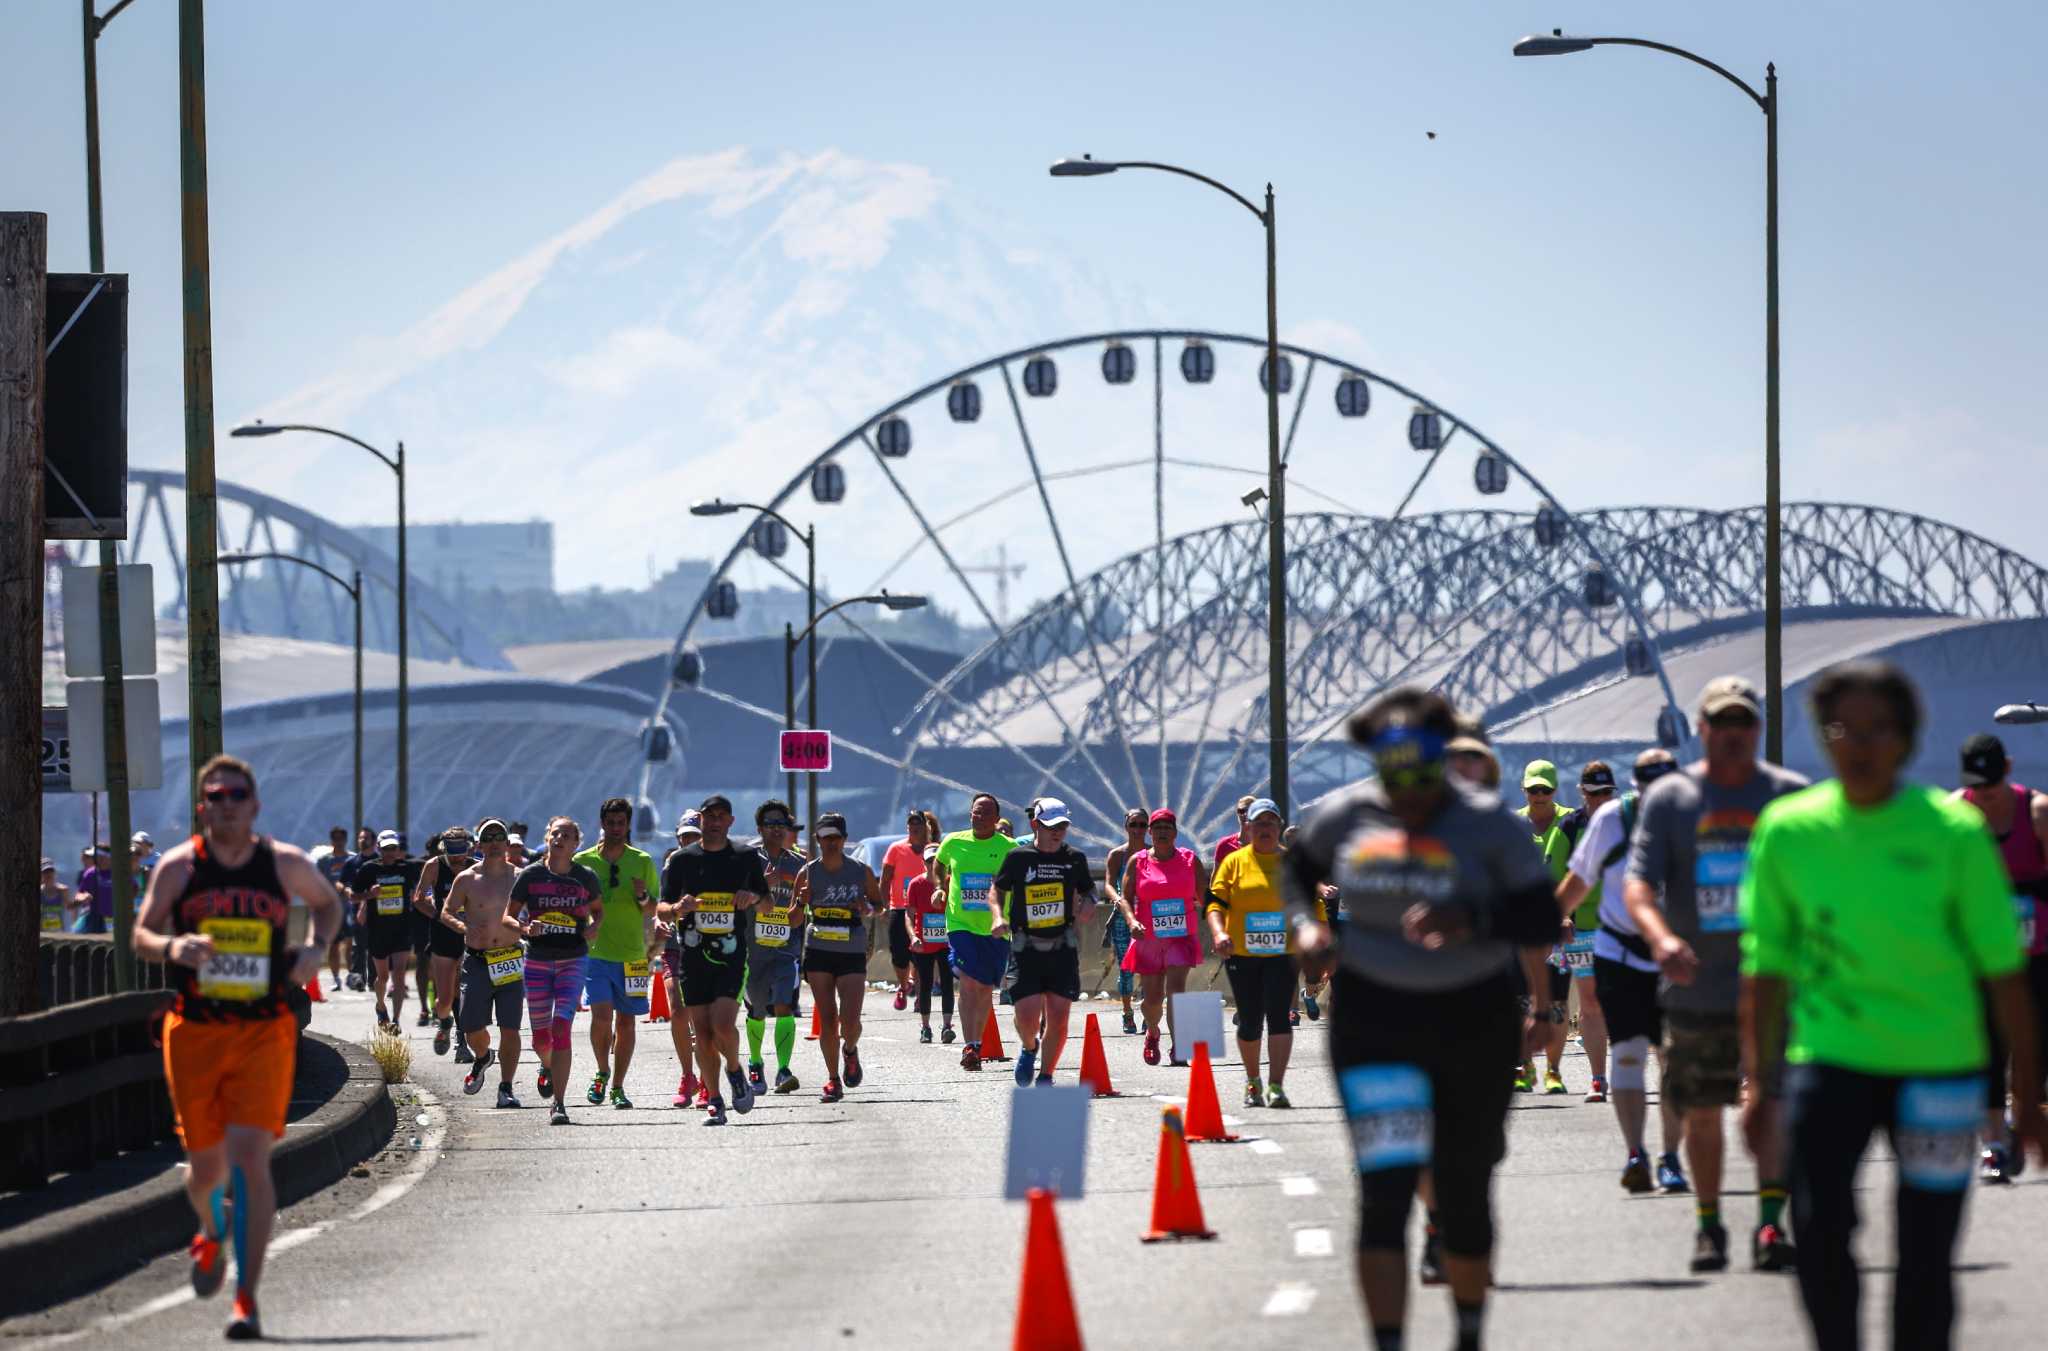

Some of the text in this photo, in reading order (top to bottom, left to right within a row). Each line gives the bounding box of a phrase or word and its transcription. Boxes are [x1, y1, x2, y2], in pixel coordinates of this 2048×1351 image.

[784, 741, 826, 760] 4:00
[538, 897, 576, 907] FIGHT
[1032, 903, 1059, 916] 8077
[700, 913, 729, 925] 9043
[1154, 916, 1184, 928] 36147
[760, 925, 787, 936] 1030
[923, 927, 945, 937] 2128
[1247, 932, 1285, 945] 34012
[490, 959, 523, 975] 15031
